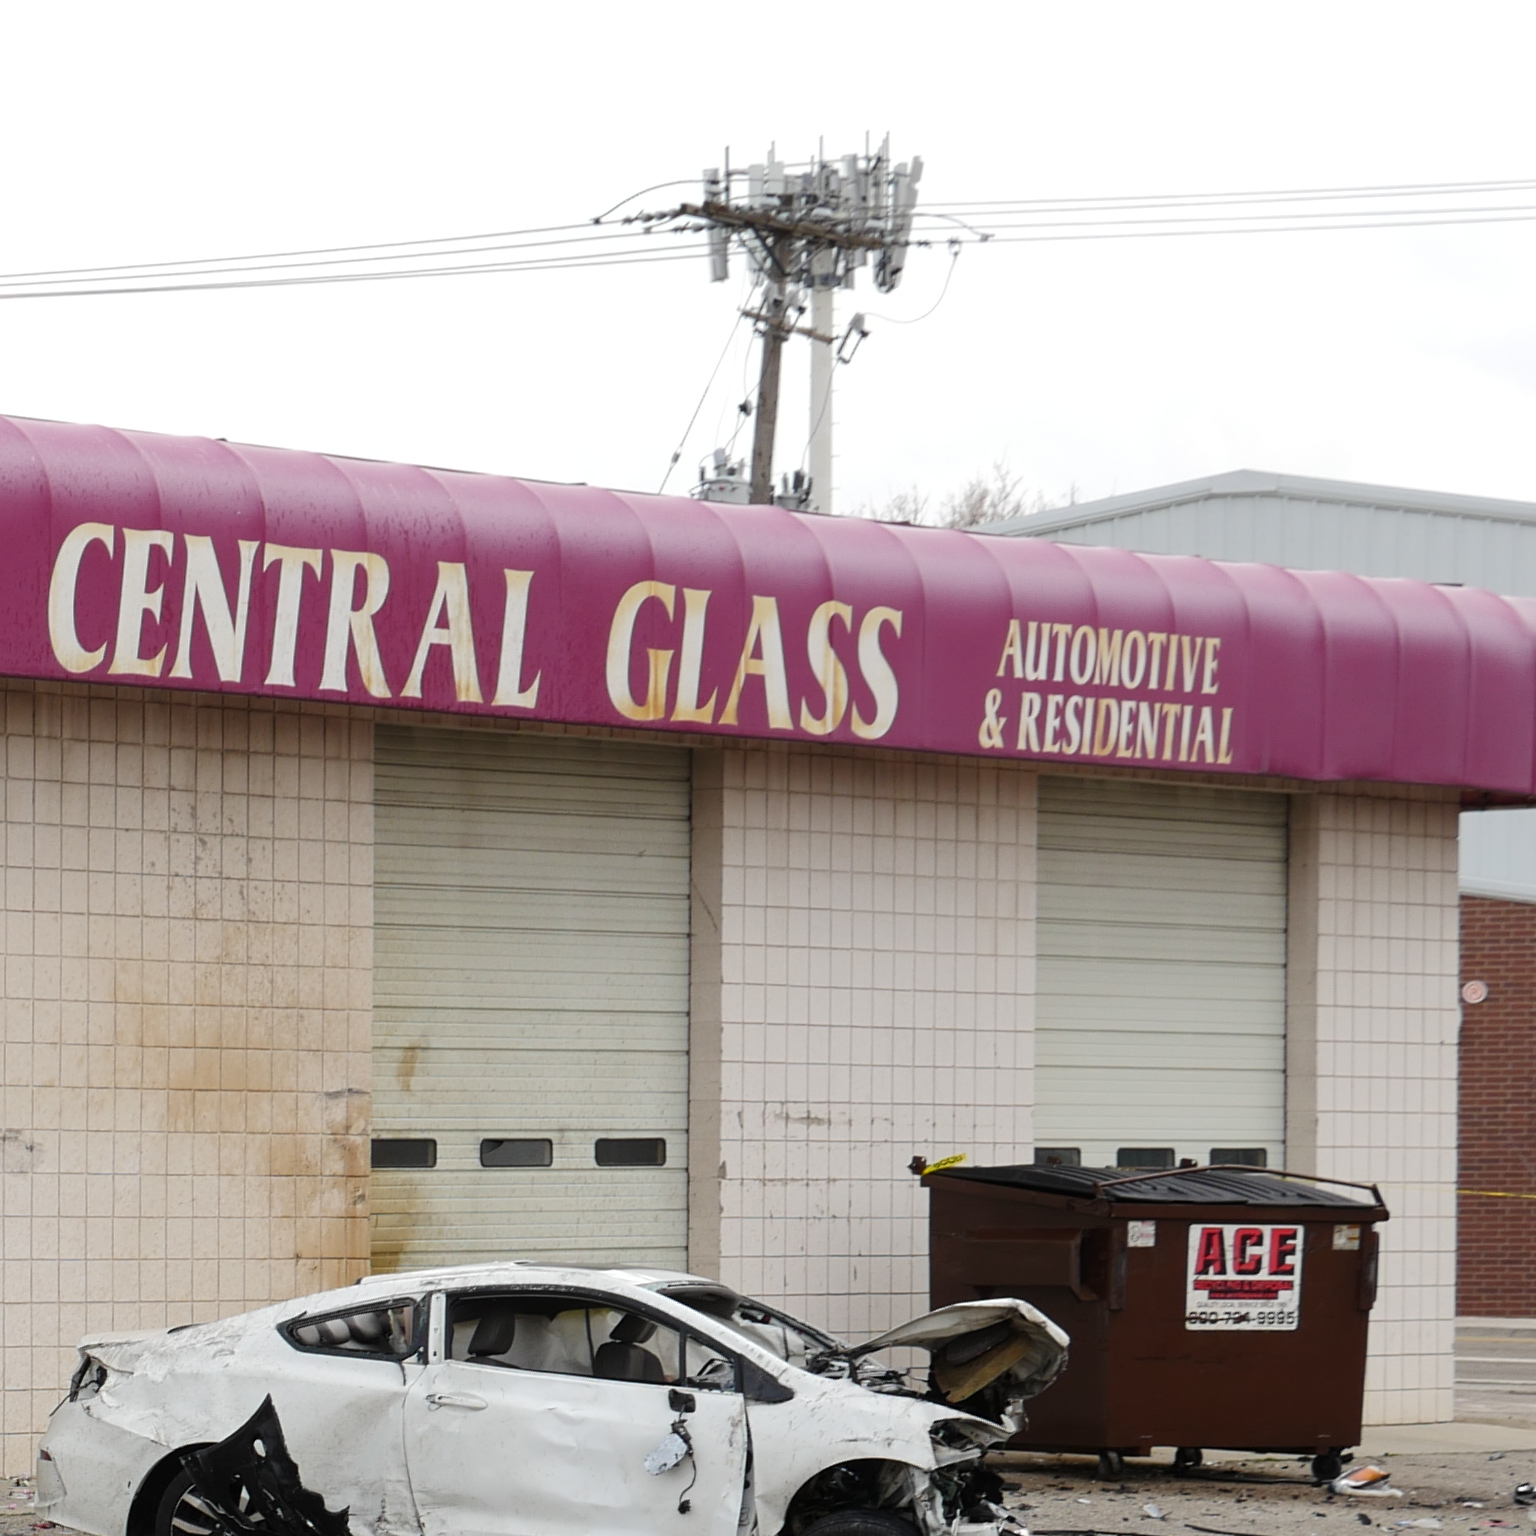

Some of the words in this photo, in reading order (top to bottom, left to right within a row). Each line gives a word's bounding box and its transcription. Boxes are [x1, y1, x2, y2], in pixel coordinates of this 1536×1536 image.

[48, 522, 541, 708] CENTRAL
[607, 580, 903, 741] GLASS
[996, 619, 1221, 694] AUTOMOTIVE
[978, 688, 1007, 749] &
[1017, 691, 1234, 765] RESIDENTIAL
[1193, 1227, 1298, 1276] ACE
